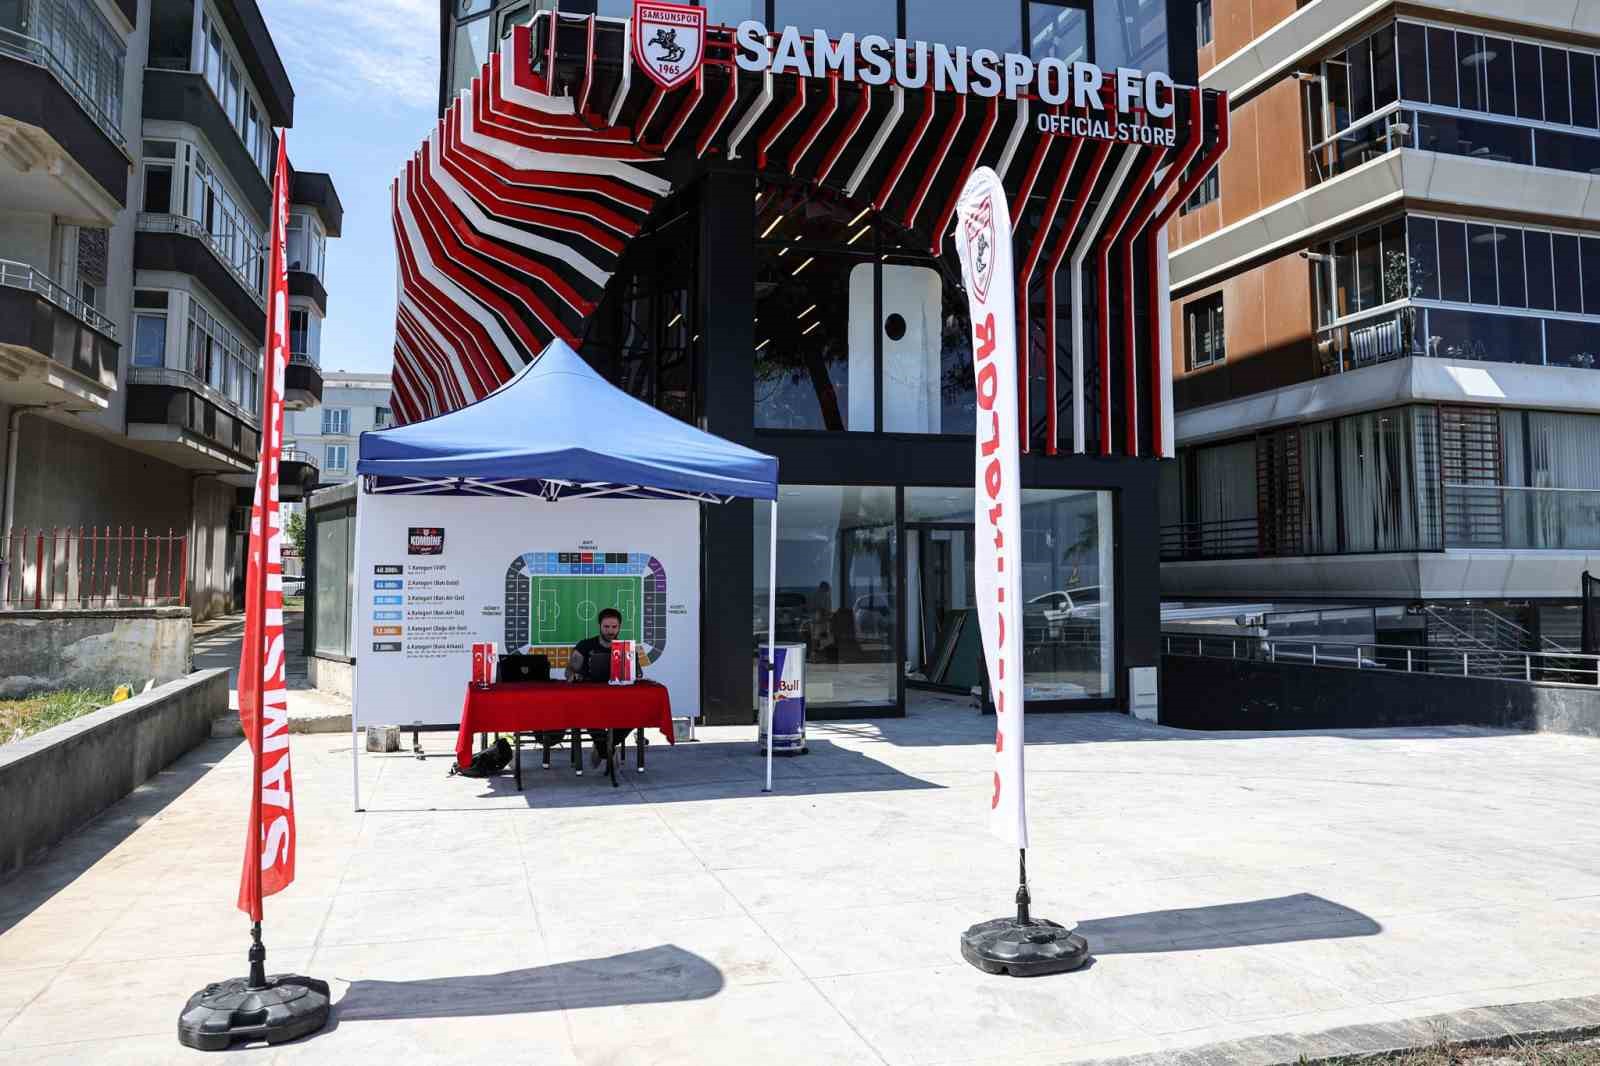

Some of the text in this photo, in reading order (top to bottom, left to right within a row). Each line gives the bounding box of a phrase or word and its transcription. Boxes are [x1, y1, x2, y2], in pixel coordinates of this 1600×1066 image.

[642, 10, 698, 24] SAMSUNSPOR
[658, 64, 680, 75] 1965
[735, 20, 1174, 118] SAMSUNSPOR FC
[1037, 112, 1176, 147] OFFICIAL STORE
[779, 680, 799, 691] Bull
